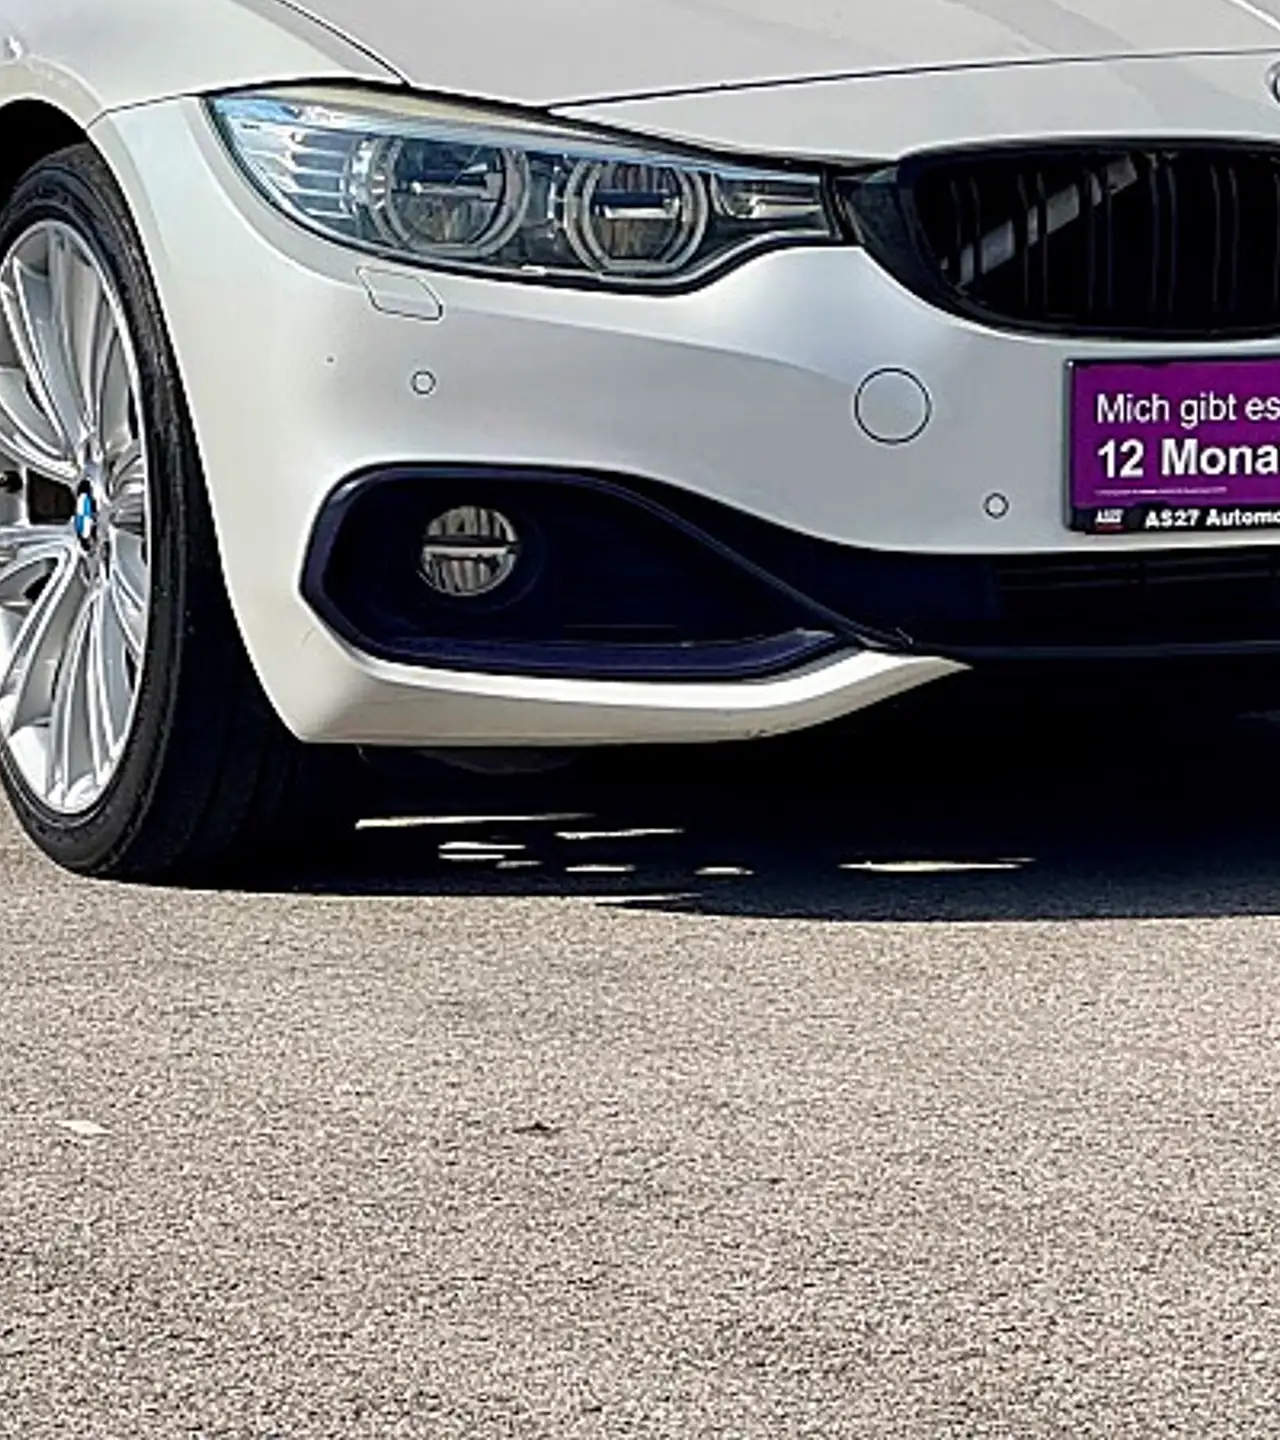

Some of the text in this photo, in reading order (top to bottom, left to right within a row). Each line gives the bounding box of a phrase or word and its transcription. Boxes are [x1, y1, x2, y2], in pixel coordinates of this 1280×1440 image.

[1097, 393, 1169, 423] Mich
[1180, 391, 1237, 429] gibt
[1097, 439, 1143, 478] 12
[1145, 509, 1200, 529] AS27
